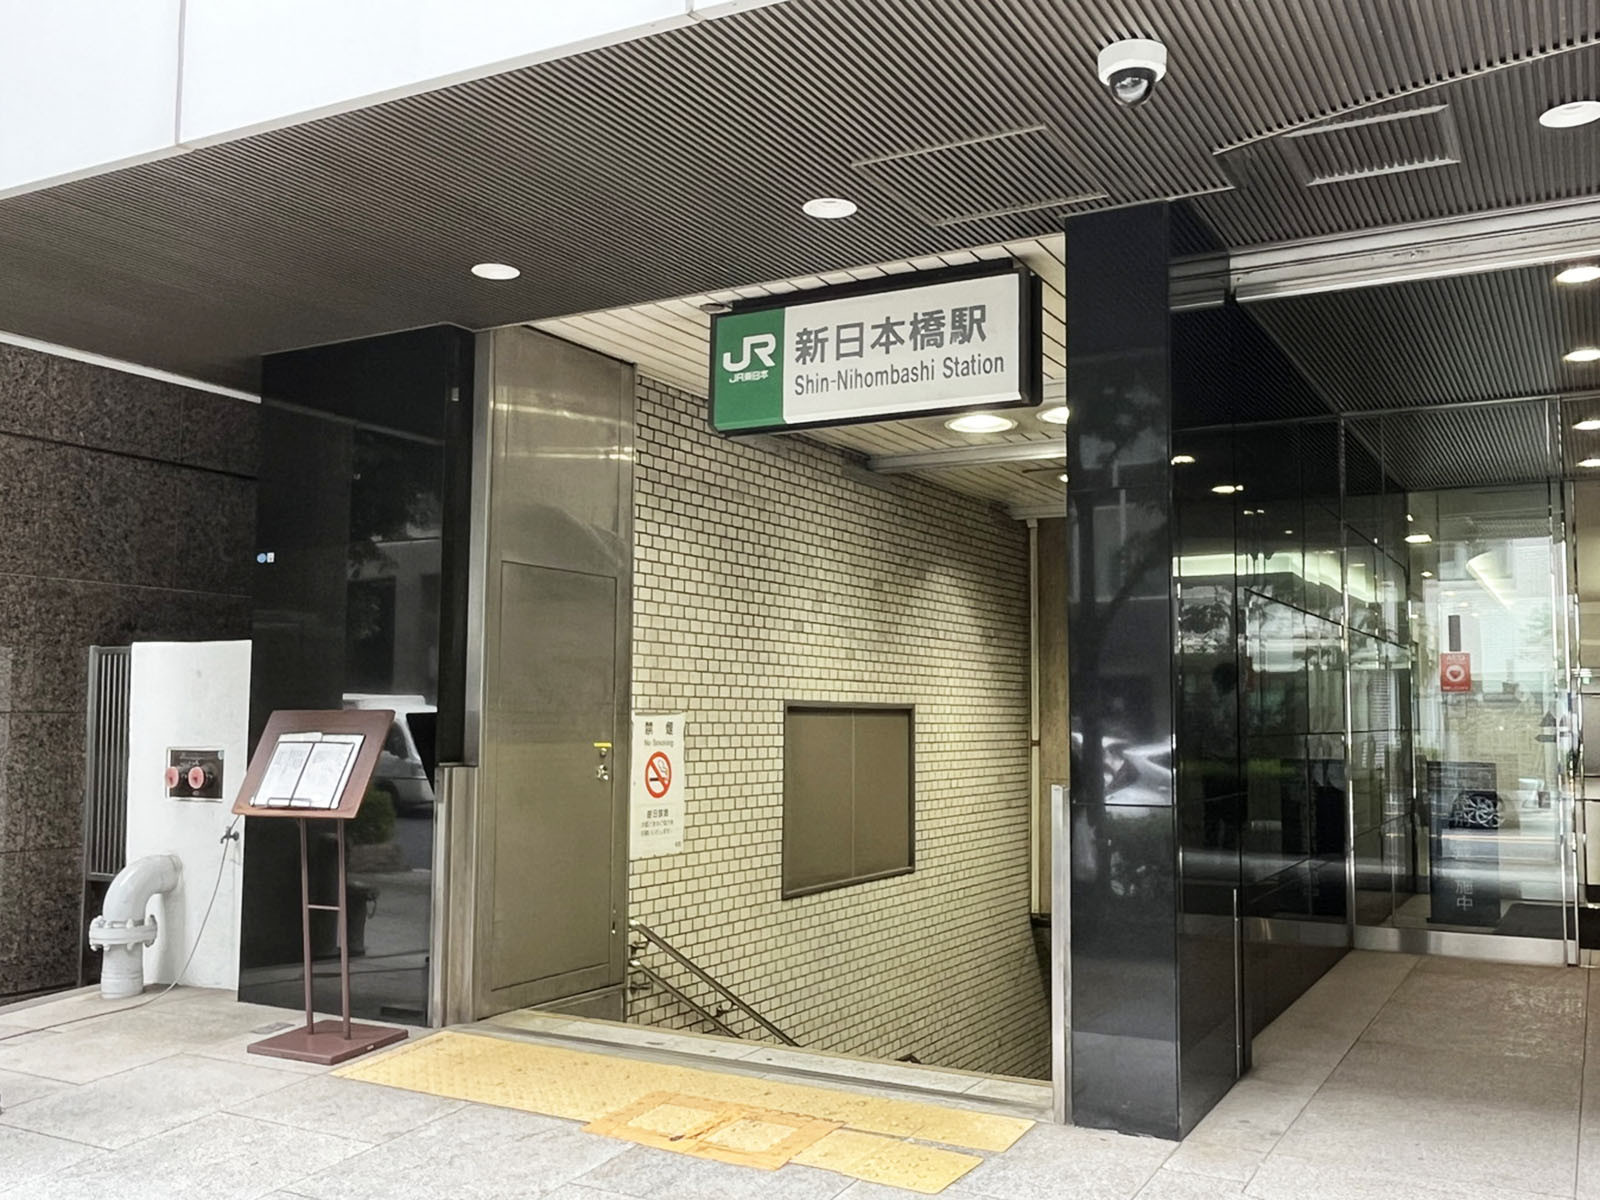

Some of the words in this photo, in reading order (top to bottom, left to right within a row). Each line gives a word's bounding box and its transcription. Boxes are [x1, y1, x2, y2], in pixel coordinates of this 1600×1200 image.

[723, 333, 776, 372] JR
[795, 304, 987, 366] 新日本橋駅
[795, 360, 935, 396] Shin-Nihombashi
[943, 354, 1004, 379] Station
